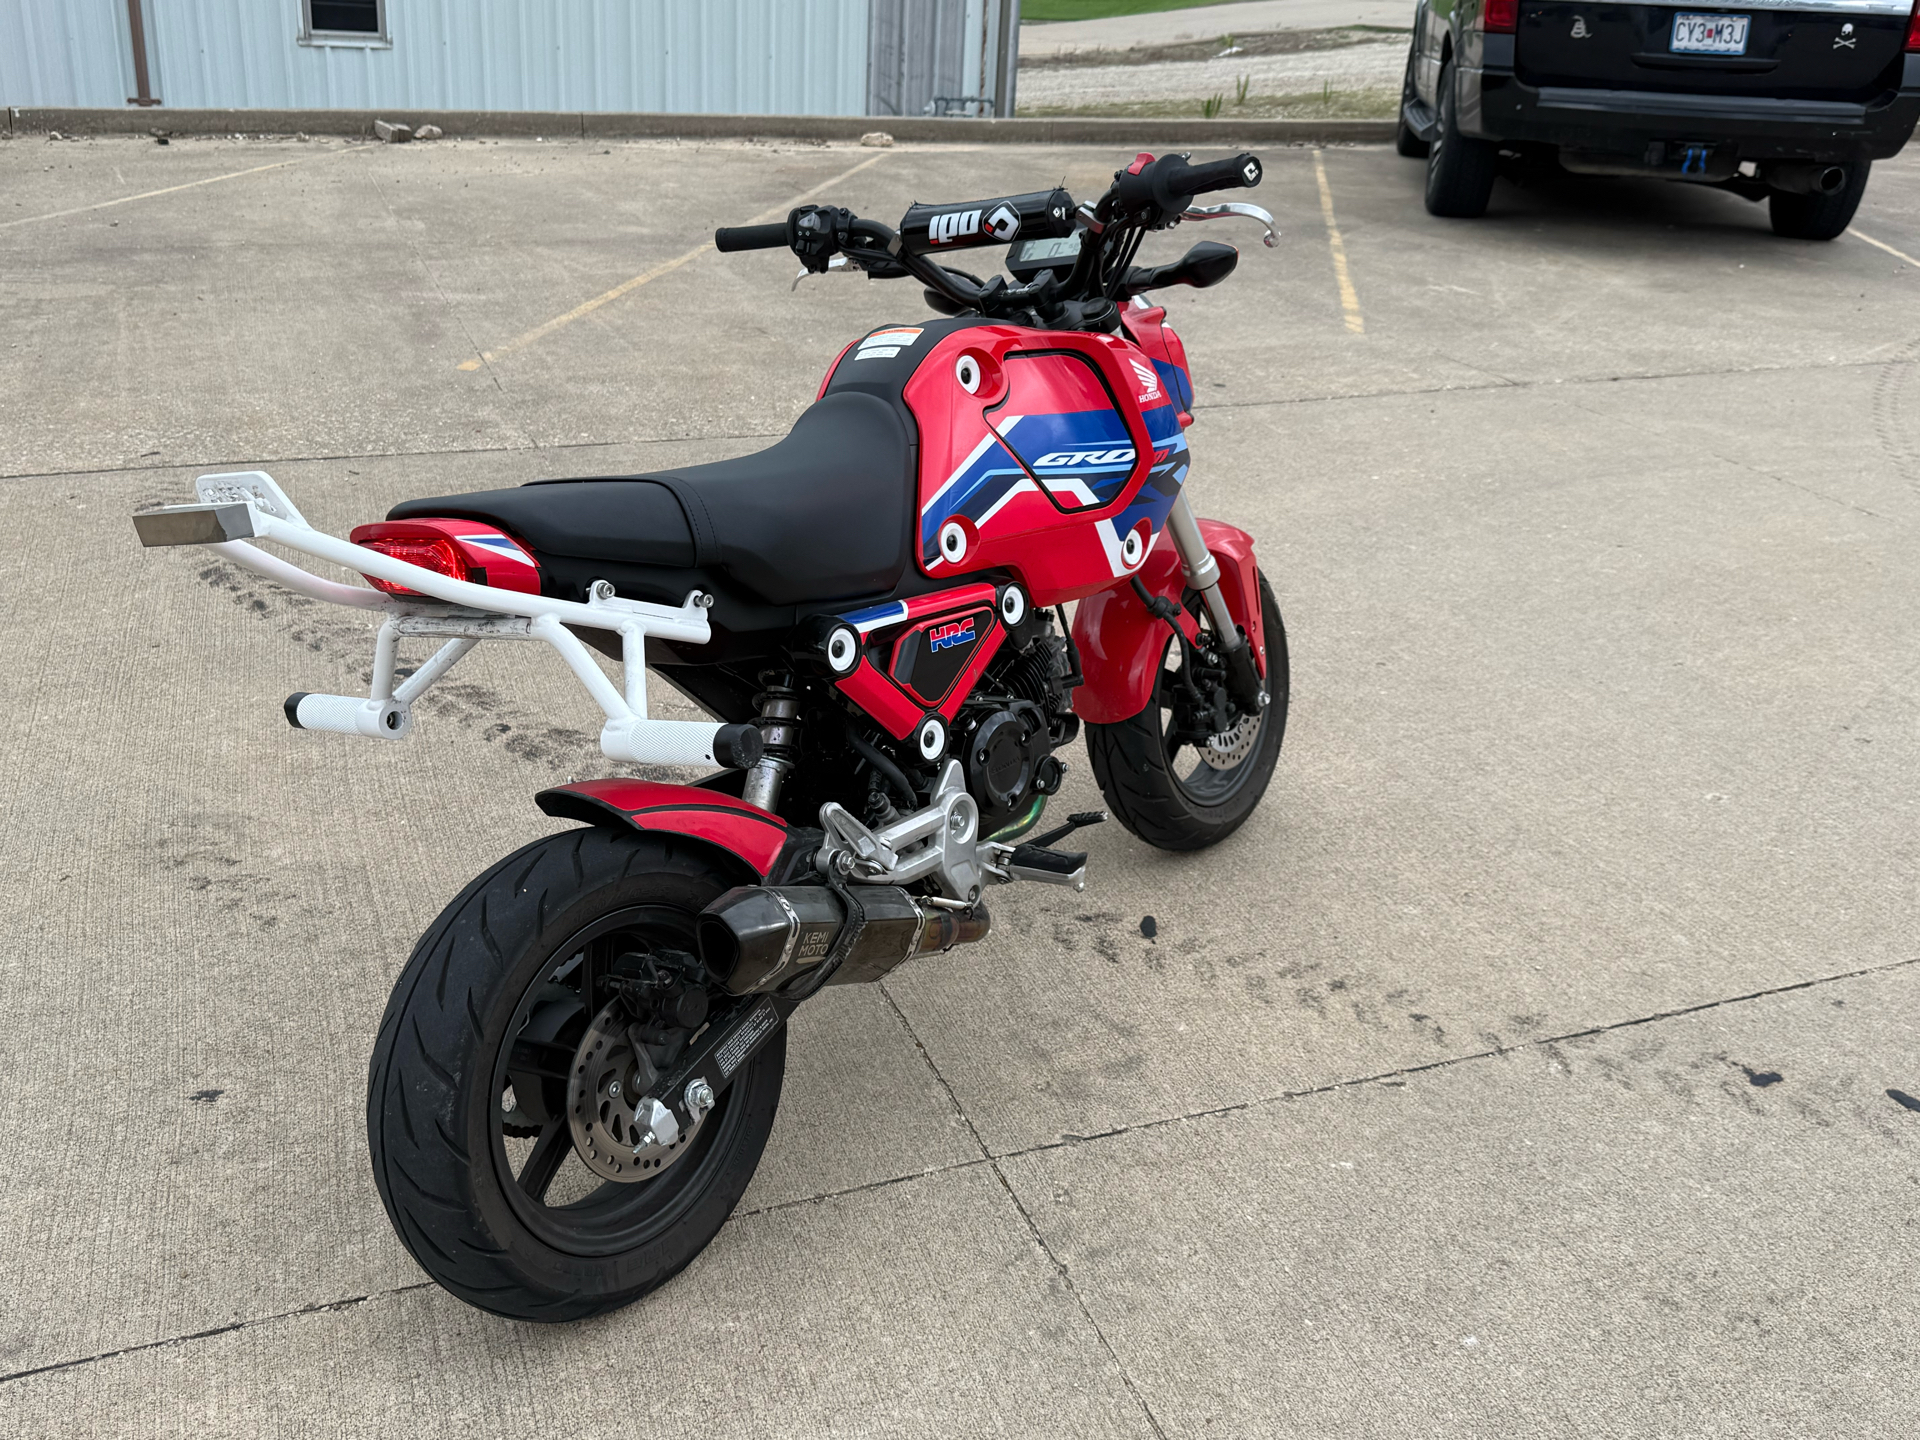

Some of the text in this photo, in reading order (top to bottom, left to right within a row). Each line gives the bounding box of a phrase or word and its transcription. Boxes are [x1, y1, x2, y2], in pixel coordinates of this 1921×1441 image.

[1675, 22, 1746, 44] CY3 M3J
[1138, 389, 1163, 403] HONDA
[929, 617, 976, 653] HRC
[802, 931, 830, 944] KEMI
[798, 943, 829, 957] MOTO
